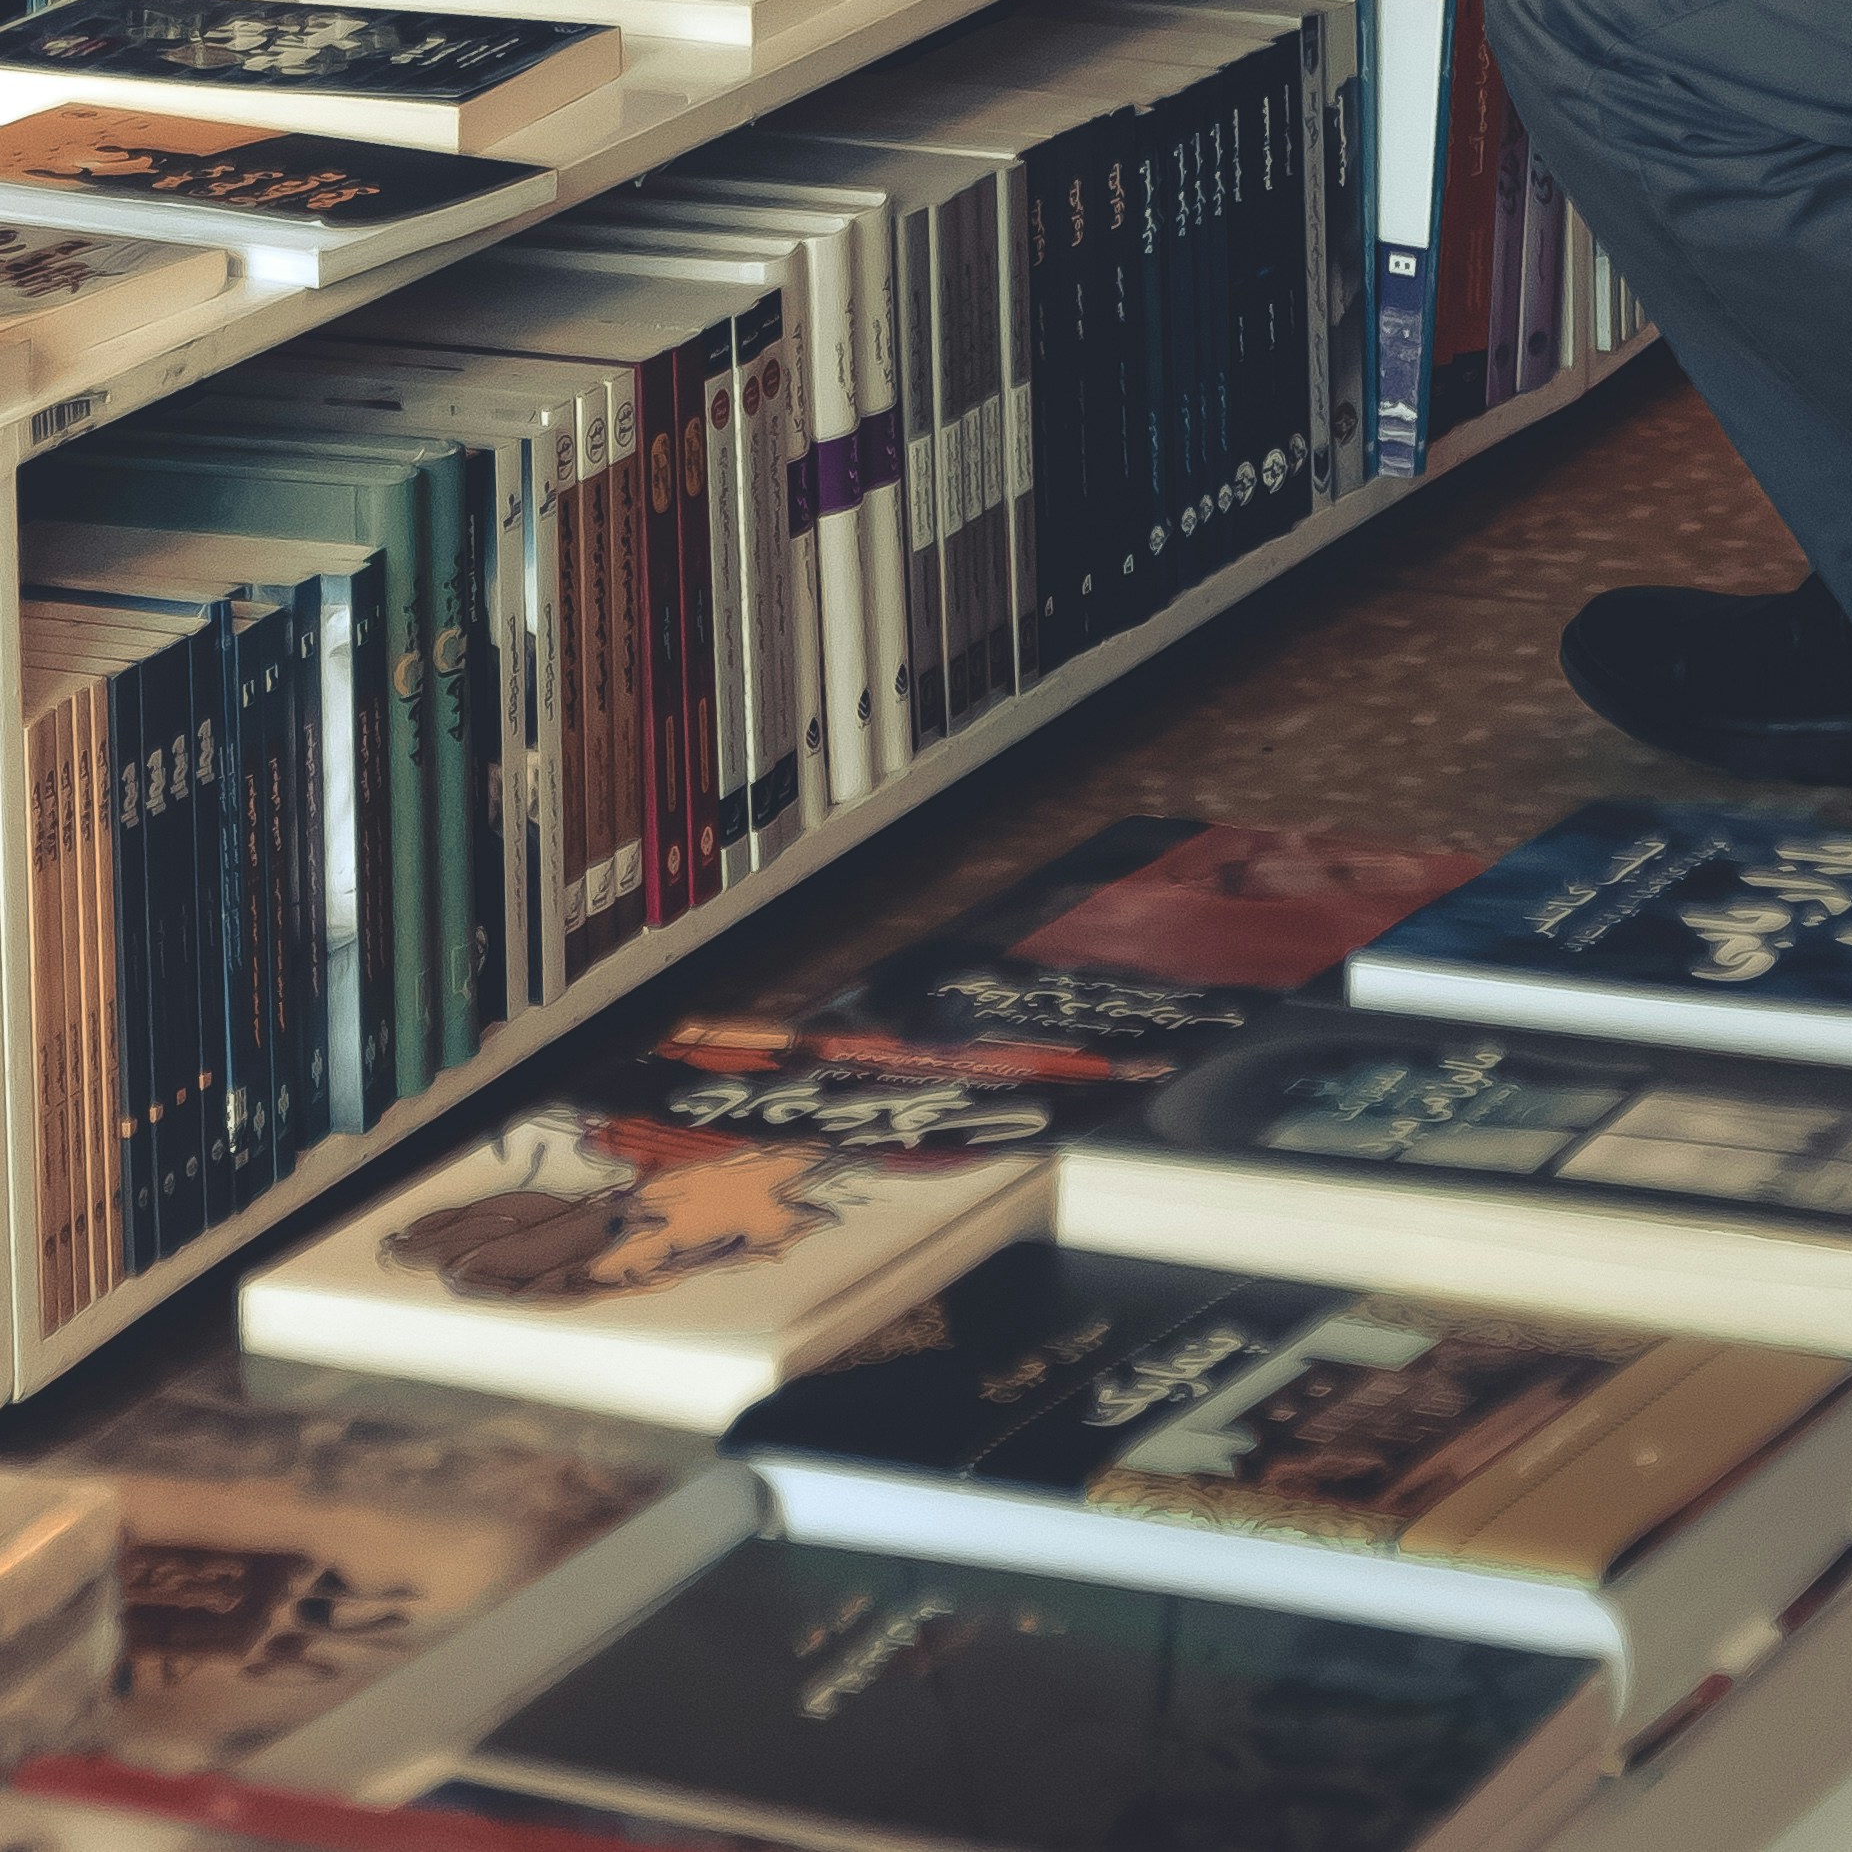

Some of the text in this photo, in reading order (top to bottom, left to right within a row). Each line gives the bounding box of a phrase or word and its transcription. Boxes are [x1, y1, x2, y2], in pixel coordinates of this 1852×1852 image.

[1522, 840, 1667, 937] فیلیپ کاتلر
[668, 1081, 1052, 1148] تازه عروس
